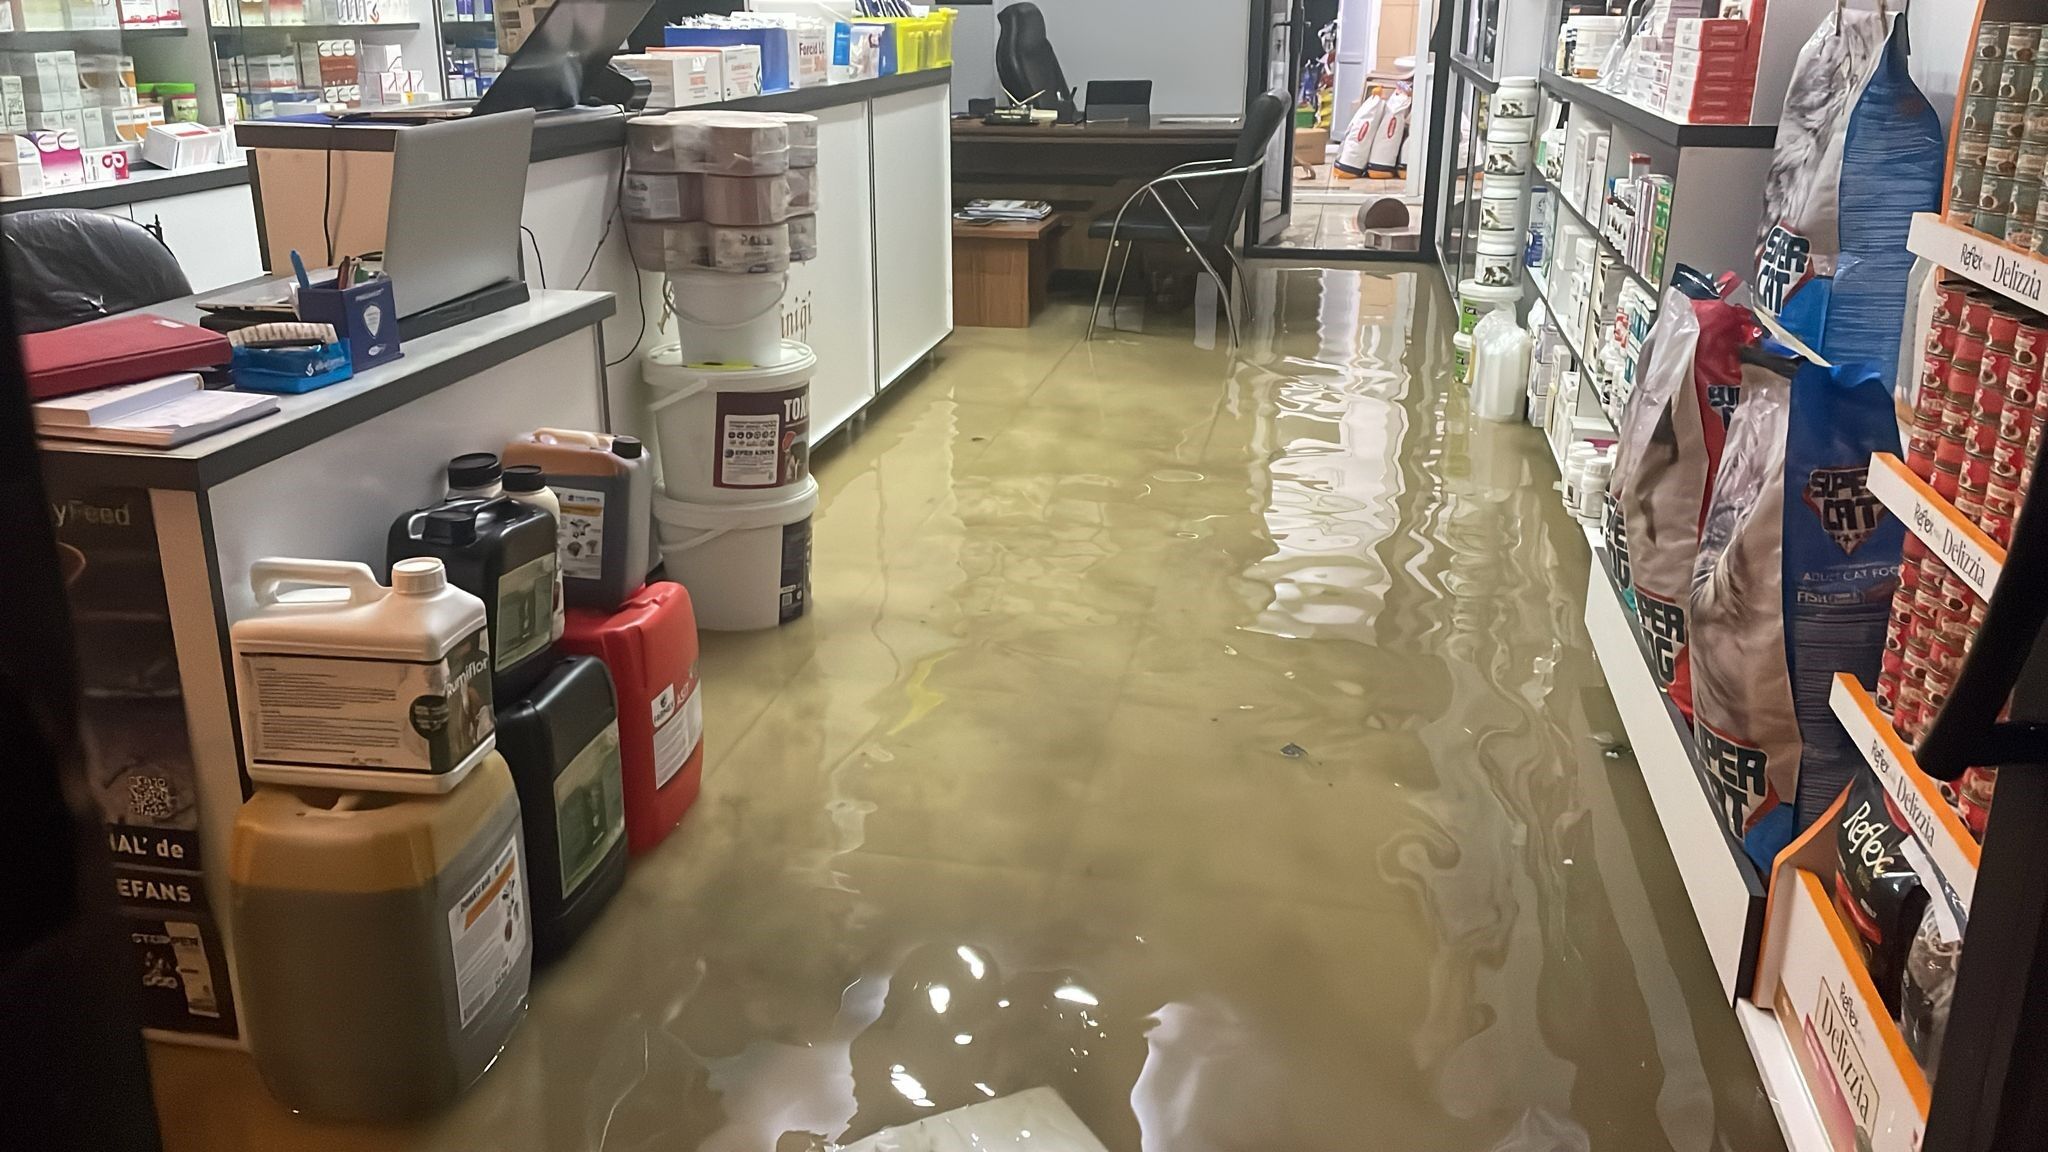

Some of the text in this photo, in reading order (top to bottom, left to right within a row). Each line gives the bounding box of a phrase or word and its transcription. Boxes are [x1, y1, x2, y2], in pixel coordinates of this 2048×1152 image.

[1993, 255, 2042, 300] Delizzia
[1823, 499, 1885, 530] CAT
[1843, 569, 1868, 581] CAT
[1943, 528, 1986, 588] Delizzia
[1896, 776, 1935, 848] Delizzia
[156, 838, 184, 859] de
[1842, 800, 1894, 878] Reflex
[1821, 997, 1869, 1124] Delizzia
